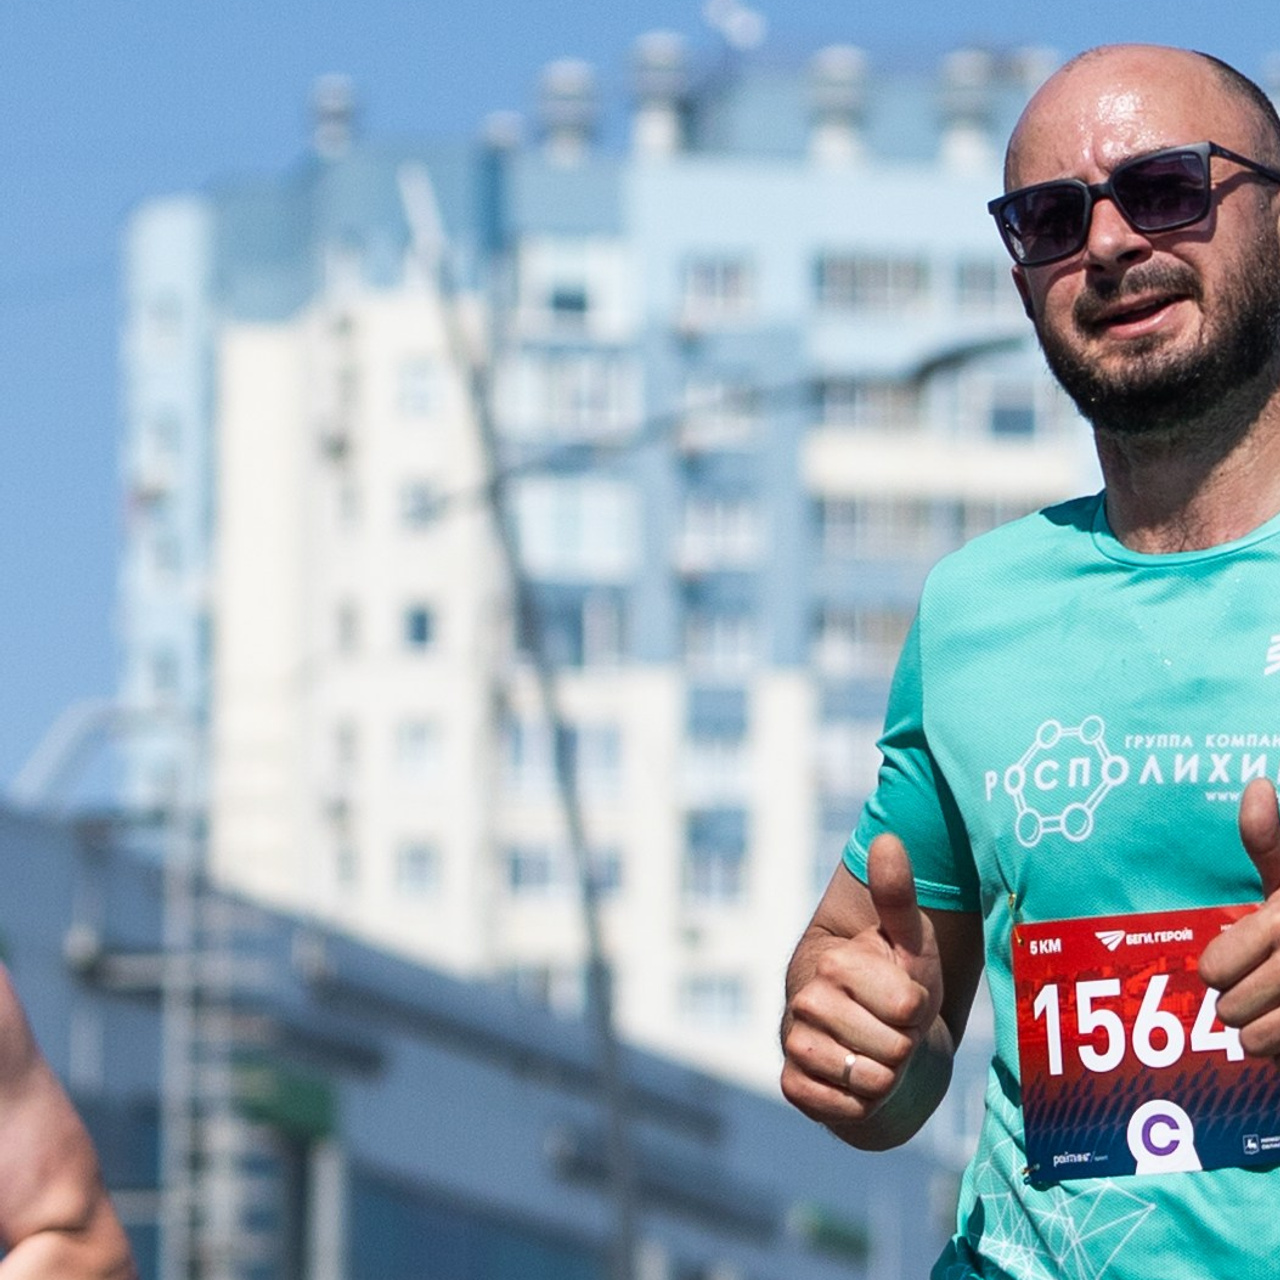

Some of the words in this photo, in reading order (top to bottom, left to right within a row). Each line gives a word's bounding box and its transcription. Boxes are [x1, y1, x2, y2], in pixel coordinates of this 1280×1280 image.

[1125, 733, 1194, 749] ГРУППА
[1030, 941, 1038, 955] 5
[1033, 974, 1245, 1076] 1564
